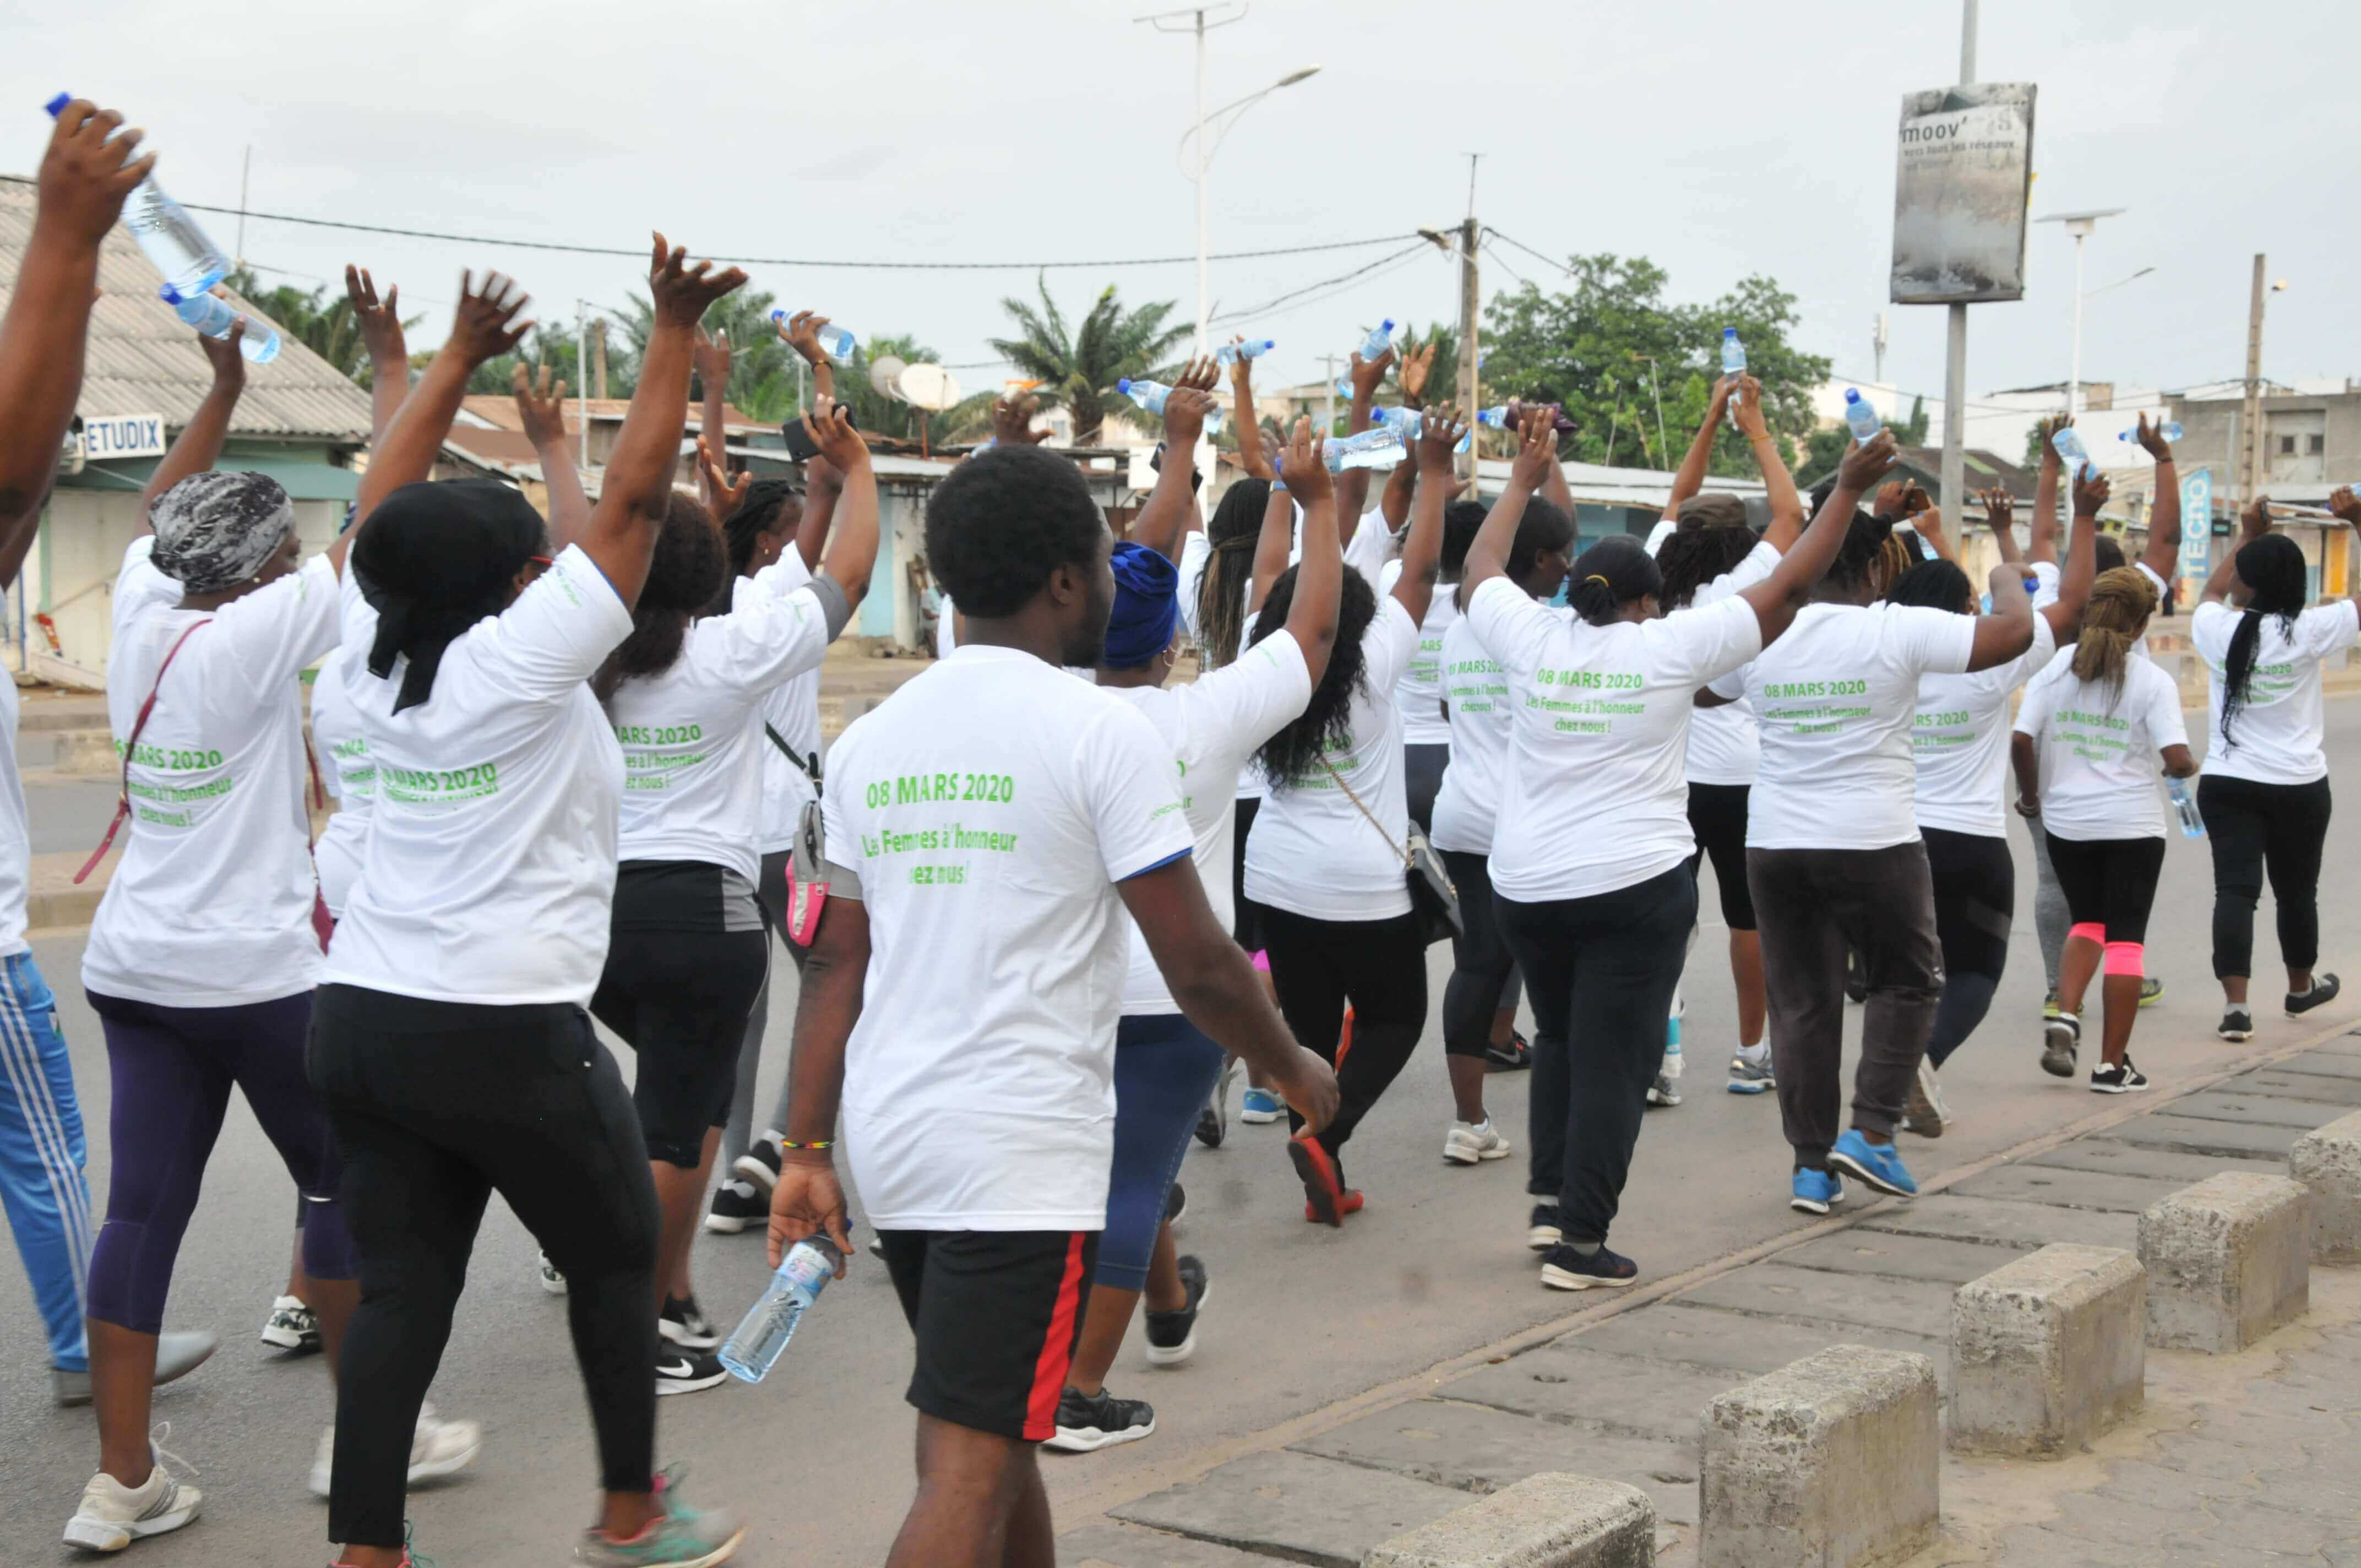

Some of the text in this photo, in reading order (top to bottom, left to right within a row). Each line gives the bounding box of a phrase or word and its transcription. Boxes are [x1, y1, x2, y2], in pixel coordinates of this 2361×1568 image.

[88, 420, 159, 451] ETUDIX
[1420, 640, 1442, 651] ARS
[1537, 668, 1642, 688] 08 MARS 2020
[1765, 680, 1866, 698] 08 MARS 2020
[1936, 710, 1969, 726] 2020
[654, 724, 702, 744] 2020
[169, 749, 223, 770] 2020
[440, 763, 497, 791] 2020
[867, 773, 1014, 809] 08 MARS 2020
